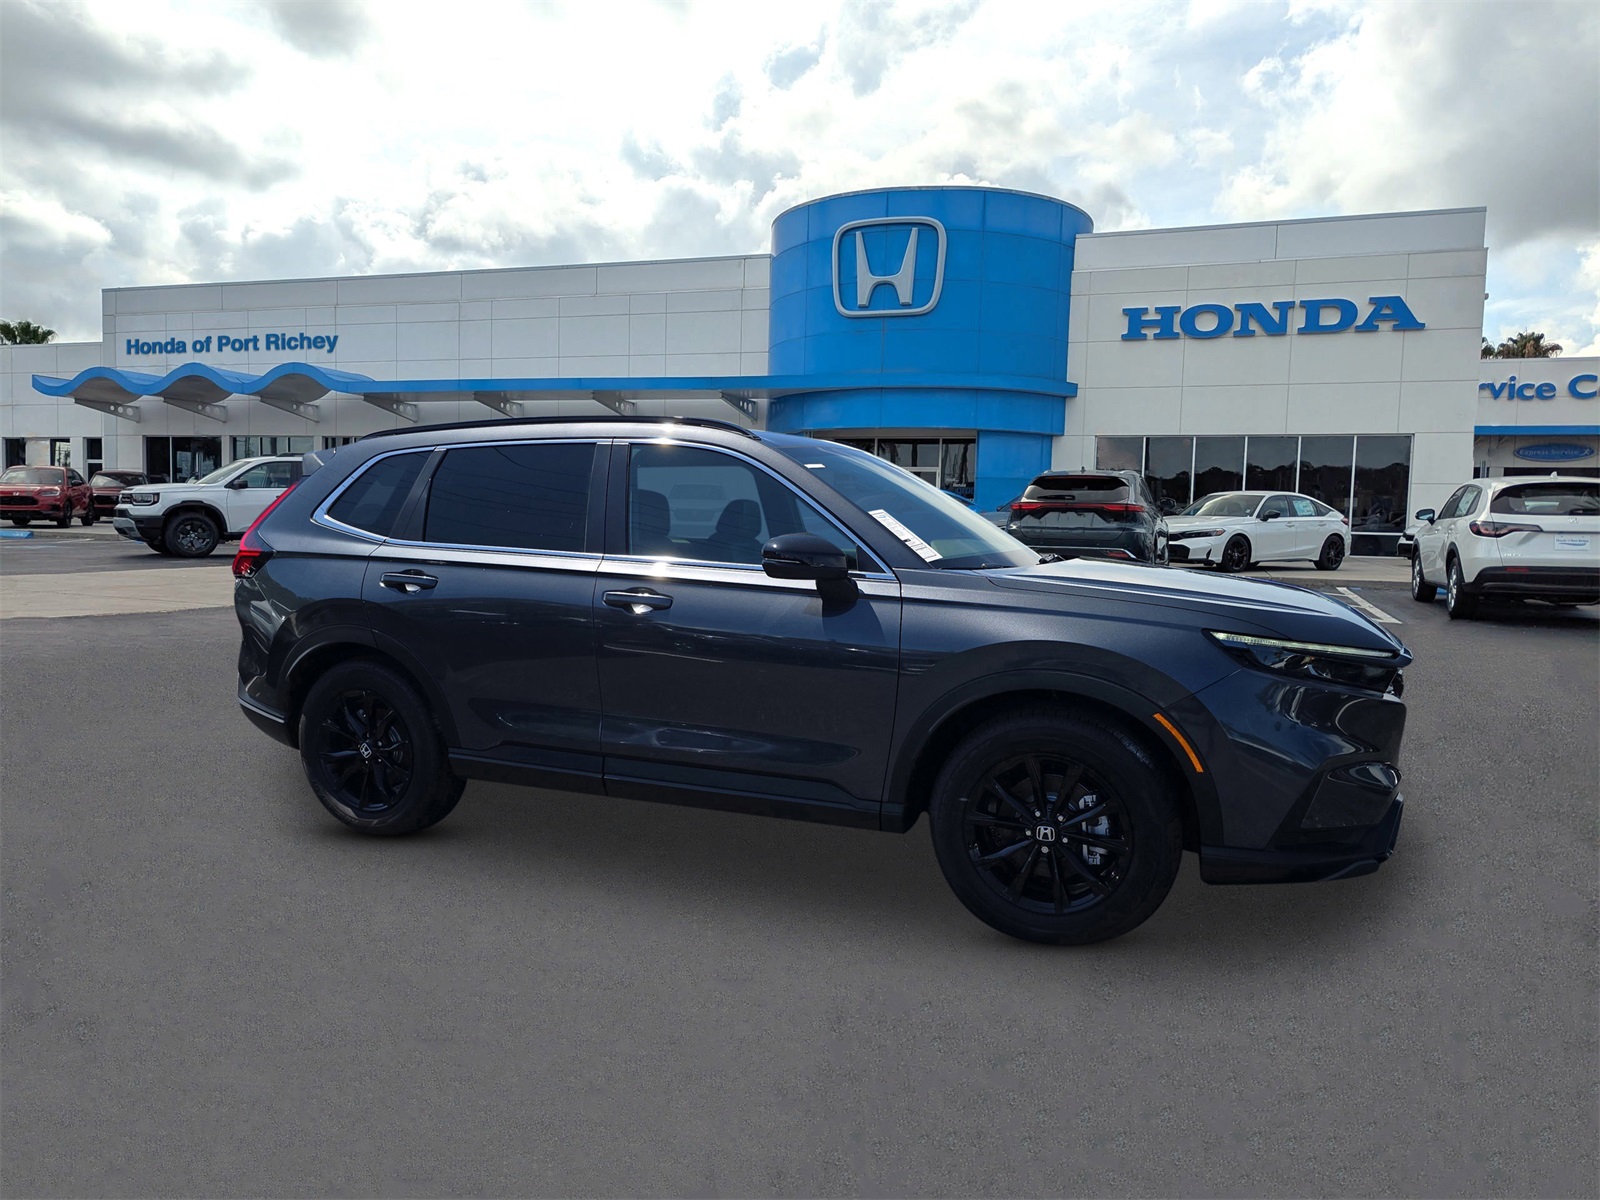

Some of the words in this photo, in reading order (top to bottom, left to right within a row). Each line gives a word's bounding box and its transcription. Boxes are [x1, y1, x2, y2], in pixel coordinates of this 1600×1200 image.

[1121, 295, 1426, 341] HONDA
[126, 337, 187, 355] Honda
[192, 335, 213, 353] of
[217, 334, 259, 353] Port
[265, 332, 339, 353] Richey
[1567, 373, 1600, 400] C
